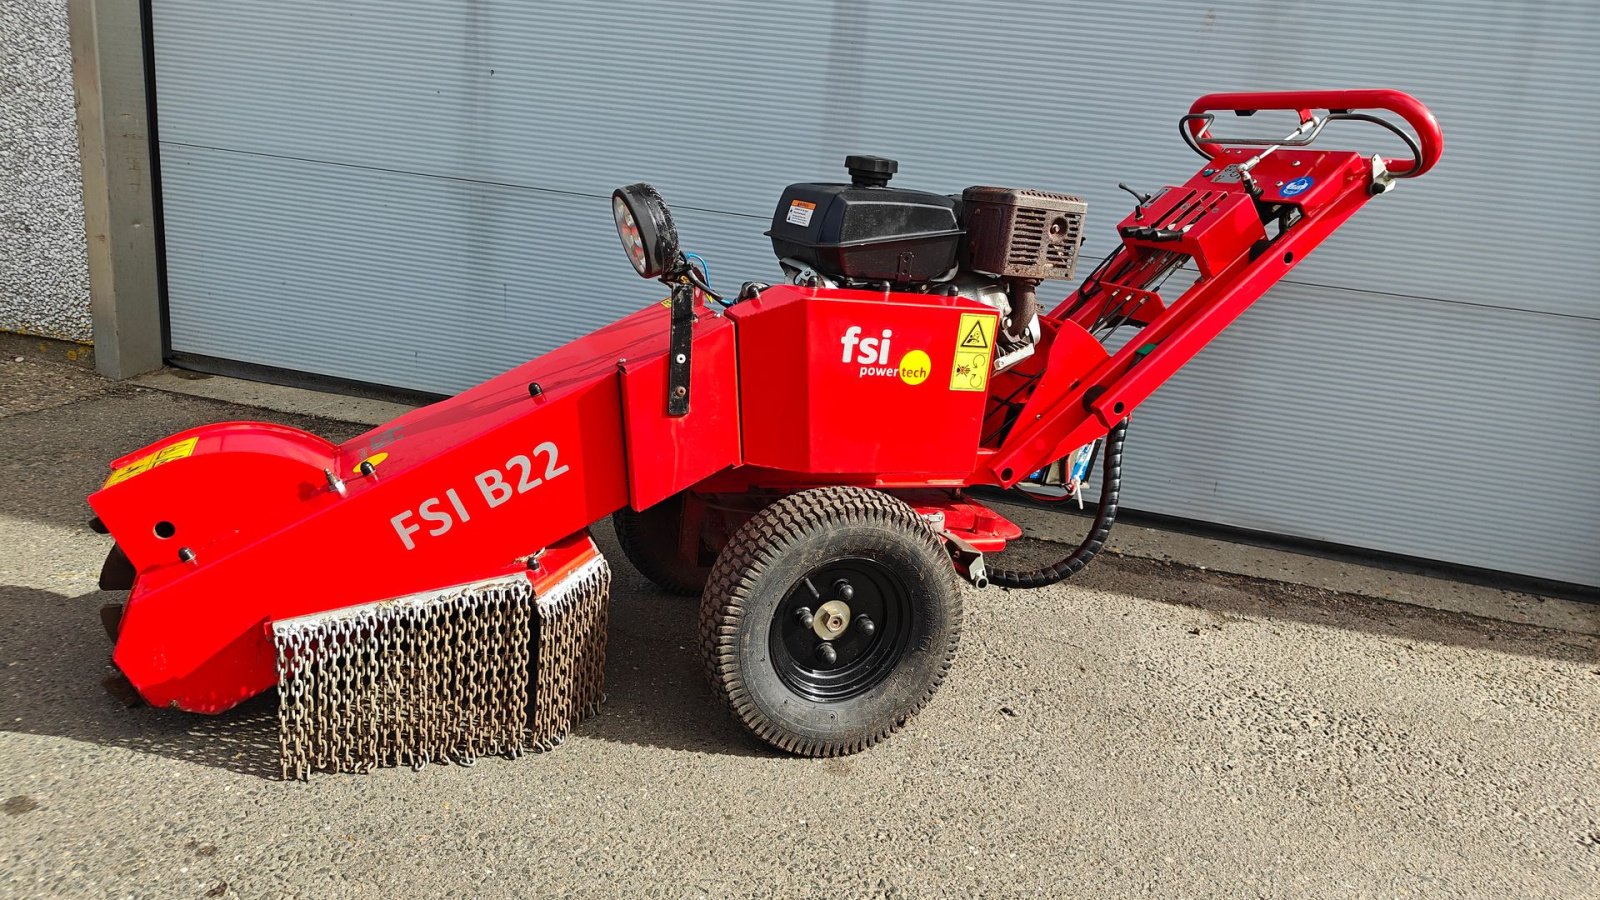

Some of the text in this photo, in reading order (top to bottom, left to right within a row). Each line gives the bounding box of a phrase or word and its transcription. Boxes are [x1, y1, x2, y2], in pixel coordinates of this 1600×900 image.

[841, 326, 893, 365] fsi
[390, 488, 471, 550] FSI
[474, 441, 570, 509] B22
